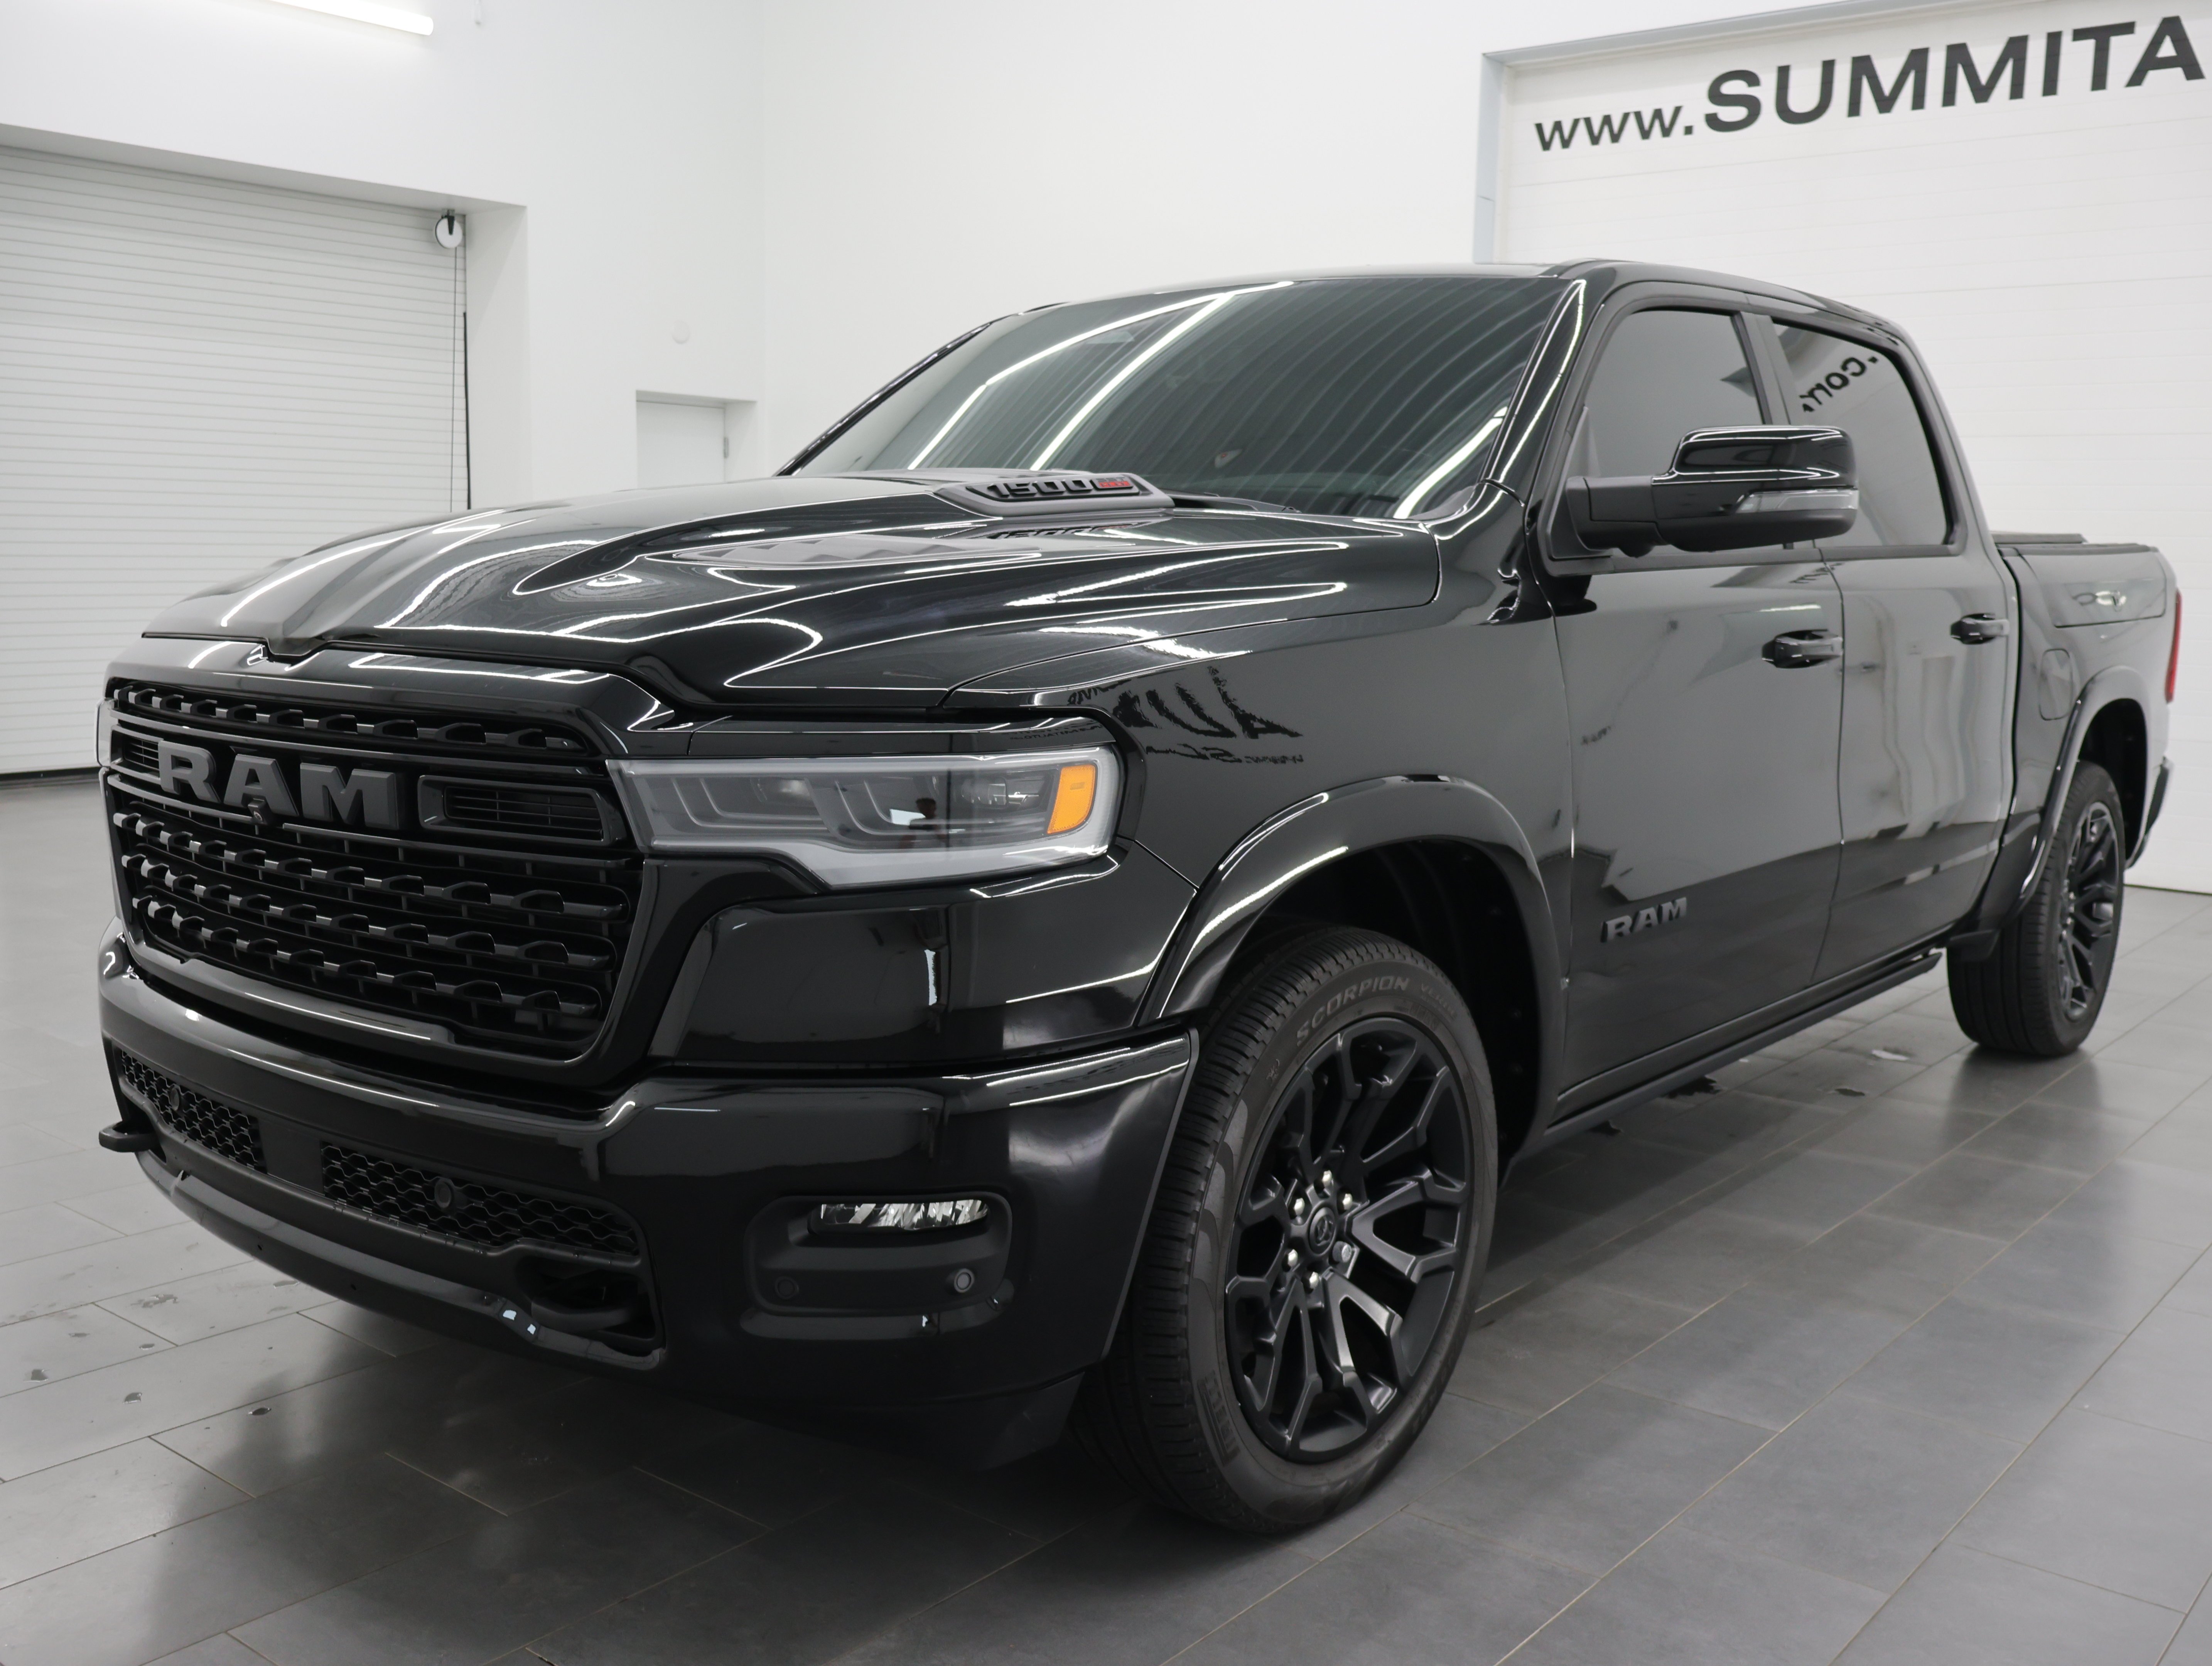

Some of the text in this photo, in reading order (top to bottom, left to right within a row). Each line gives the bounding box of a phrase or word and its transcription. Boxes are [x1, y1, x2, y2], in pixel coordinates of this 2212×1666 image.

[987, 479, 1093, 497] 1500
[158, 740, 399, 830] RAM
[1601, 897, 1687, 943] RAM
[1297, 975, 1410, 1047] SCORPION
